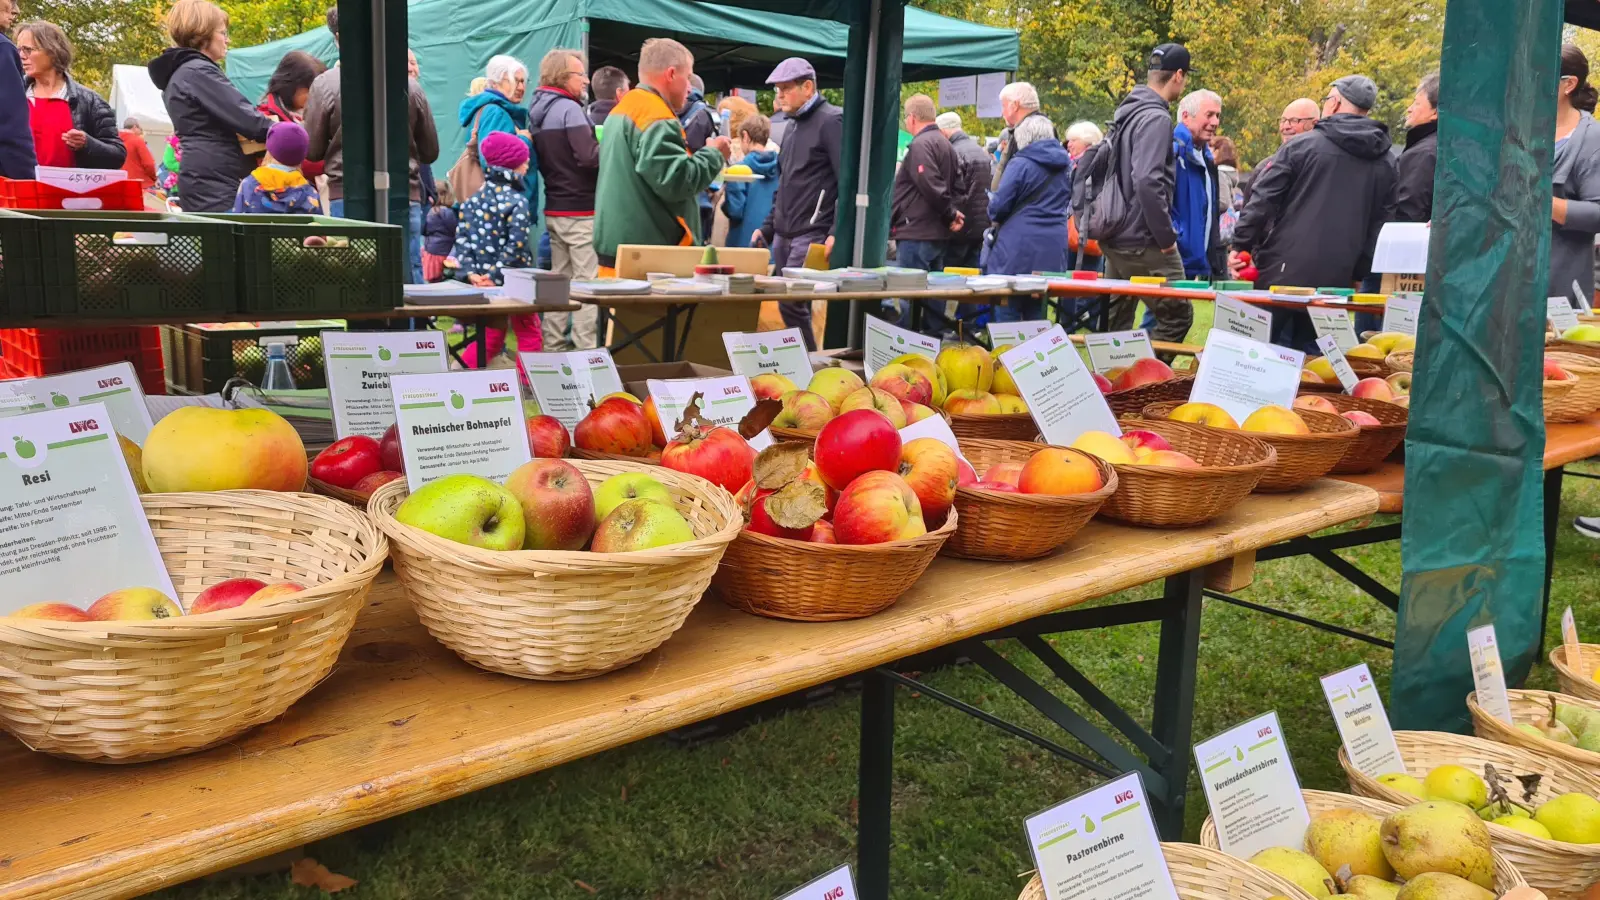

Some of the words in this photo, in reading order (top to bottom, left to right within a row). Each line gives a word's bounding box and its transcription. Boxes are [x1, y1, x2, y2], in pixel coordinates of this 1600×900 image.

[415, 341, 436, 349] LWG
[758, 361, 780, 369] Reanda
[1040, 365, 1059, 379] Rebella
[362, 370, 392, 379] Purpu
[97, 376, 123, 389] LWG
[489, 382, 510, 393] LWG
[723, 385, 742, 396] LWG
[69, 419, 99, 434] LWG
[412, 422, 465, 436] Rheinischer
[466, 417, 512, 431] Bohnapfel
[712, 416, 735, 425] ender
[21, 469, 51, 487] Resi
[33, 497, 46, 505] und
[46, 485, 97, 502] Wirtschaftsapfel
[14, 507, 50, 520] Mitte/Ende
[50, 499, 83, 512] September
[30, 515, 54, 527] Februar
[18, 546, 30, 555] aus
[93, 525, 108, 535] 1996
[1213, 757, 1279, 792] Vereinsdechantsbirne
[1114, 789, 1134, 804] LWG
[1066, 832, 1125, 865] Pastorenbirne
